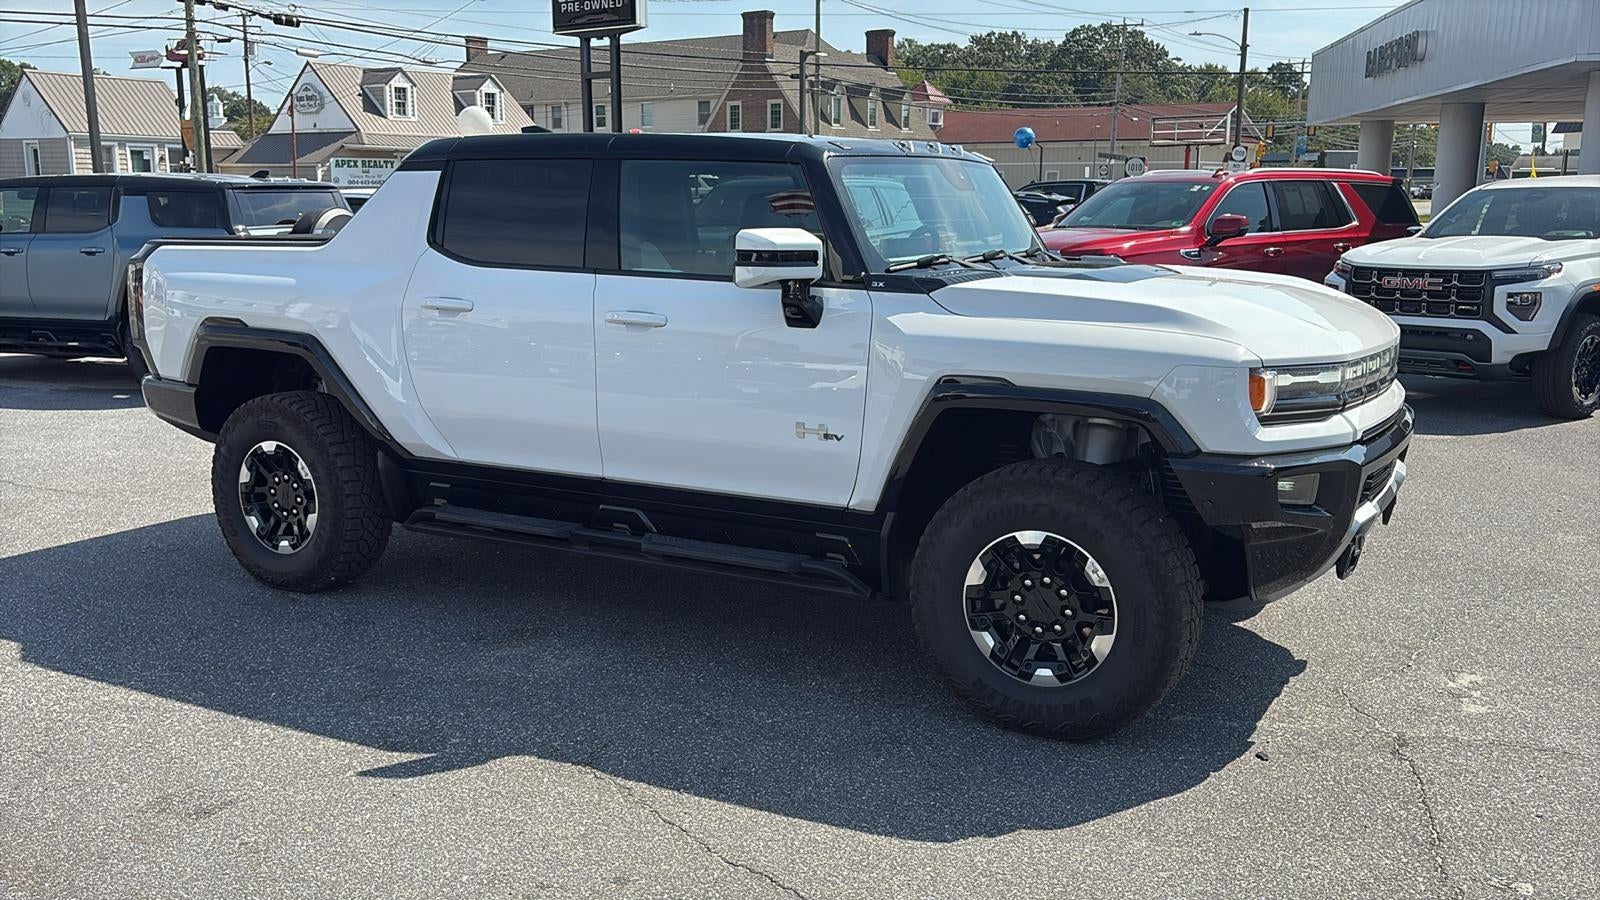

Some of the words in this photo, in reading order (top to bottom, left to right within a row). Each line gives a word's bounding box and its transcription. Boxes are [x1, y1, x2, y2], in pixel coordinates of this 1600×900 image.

[561, 0, 623, 13] PRE-OWNED
[334, 159, 359, 168] APEX
[361, 159, 395, 168] REALTY
[1127, 163, 1143, 171] 1010
[1381, 276, 1443, 290] GMC
